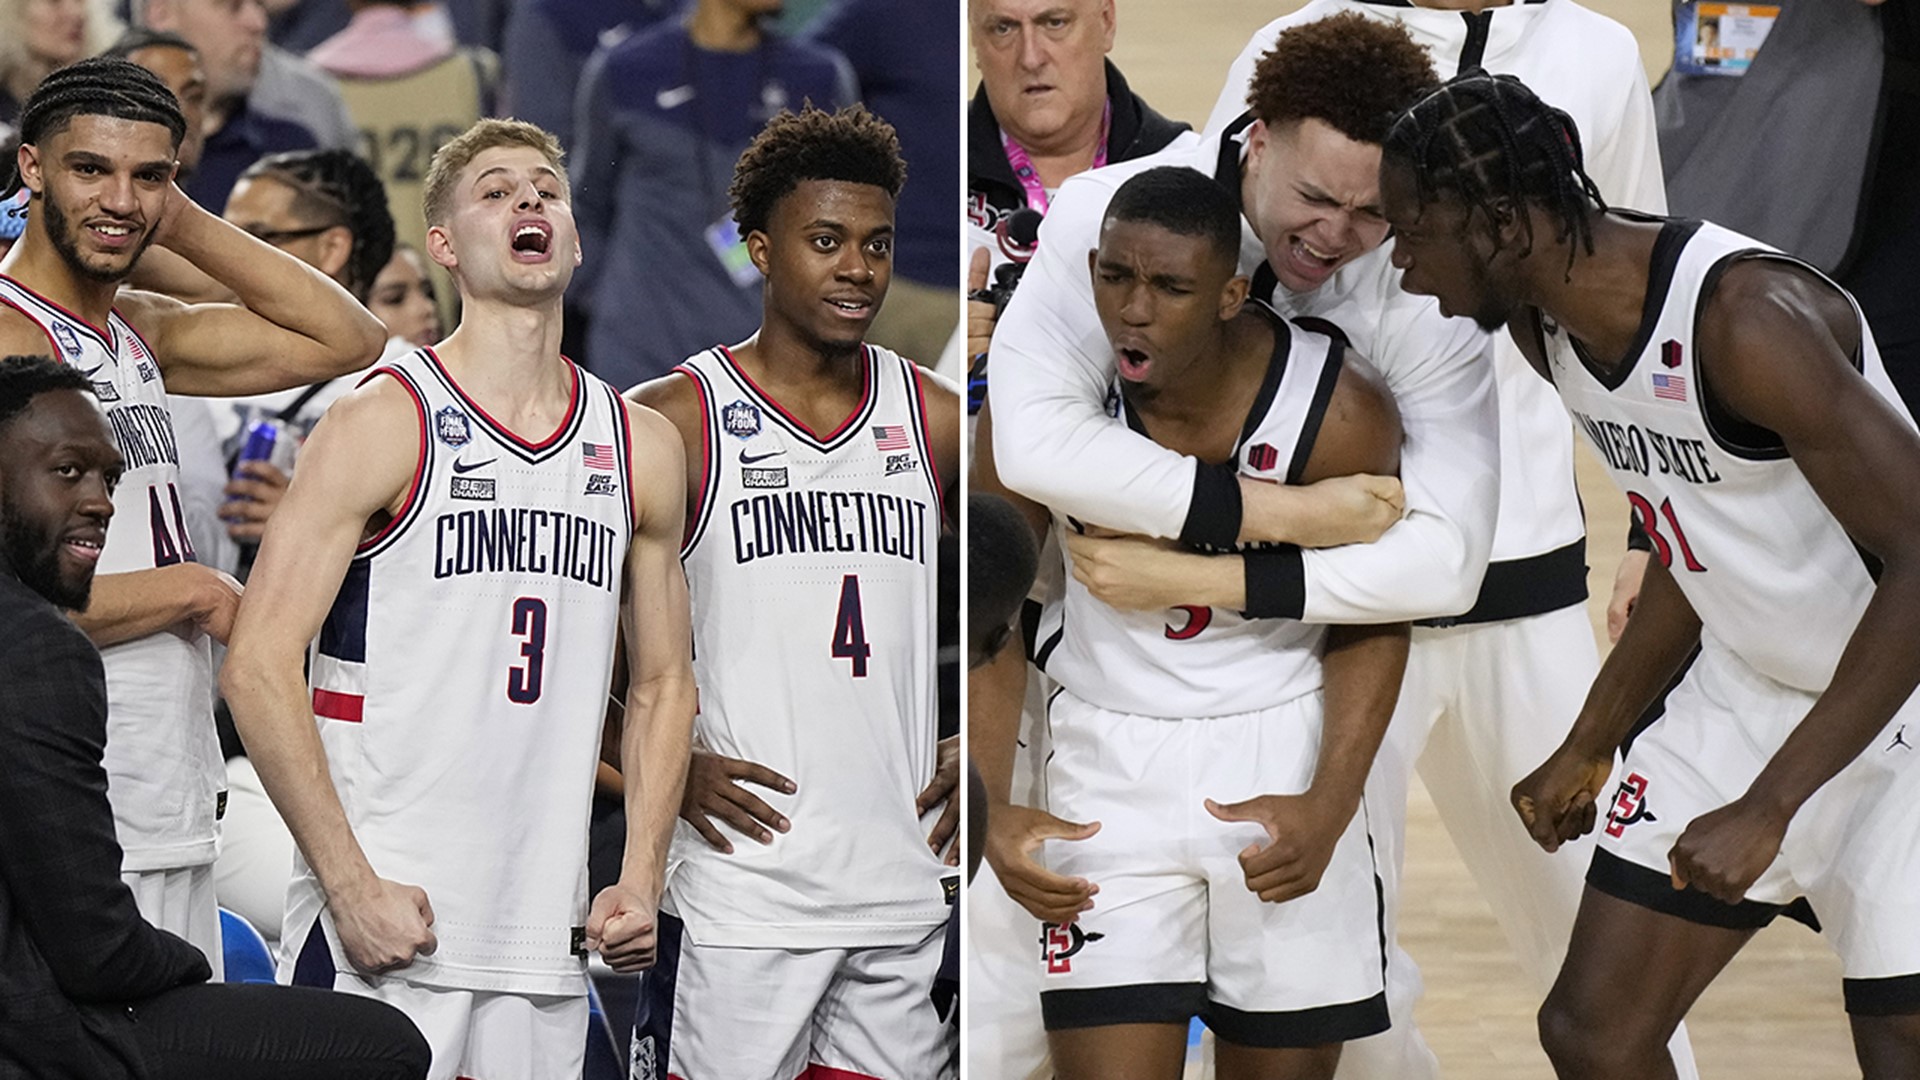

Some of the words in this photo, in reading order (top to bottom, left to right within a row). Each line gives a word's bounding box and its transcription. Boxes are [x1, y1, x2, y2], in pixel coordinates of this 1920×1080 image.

[727, 408, 754, 420] FINAL
[440, 415, 464, 427] FINAL
[732, 419, 758, 430] FOUR
[886, 453, 910, 464] BIG
[1645, 427, 1721, 484] STATE
[885, 460, 918, 472] EAST
[589, 473, 612, 484] BIG
[452, 488, 494, 499] CHANGE
[586, 482, 618, 493] EAST
[148, 483, 197, 568] 44
[730, 491, 926, 565] CONNECTICUT
[434, 508, 616, 592] CONNECTICUT
[831, 573, 871, 678] 4
[507, 596, 548, 705] 3
